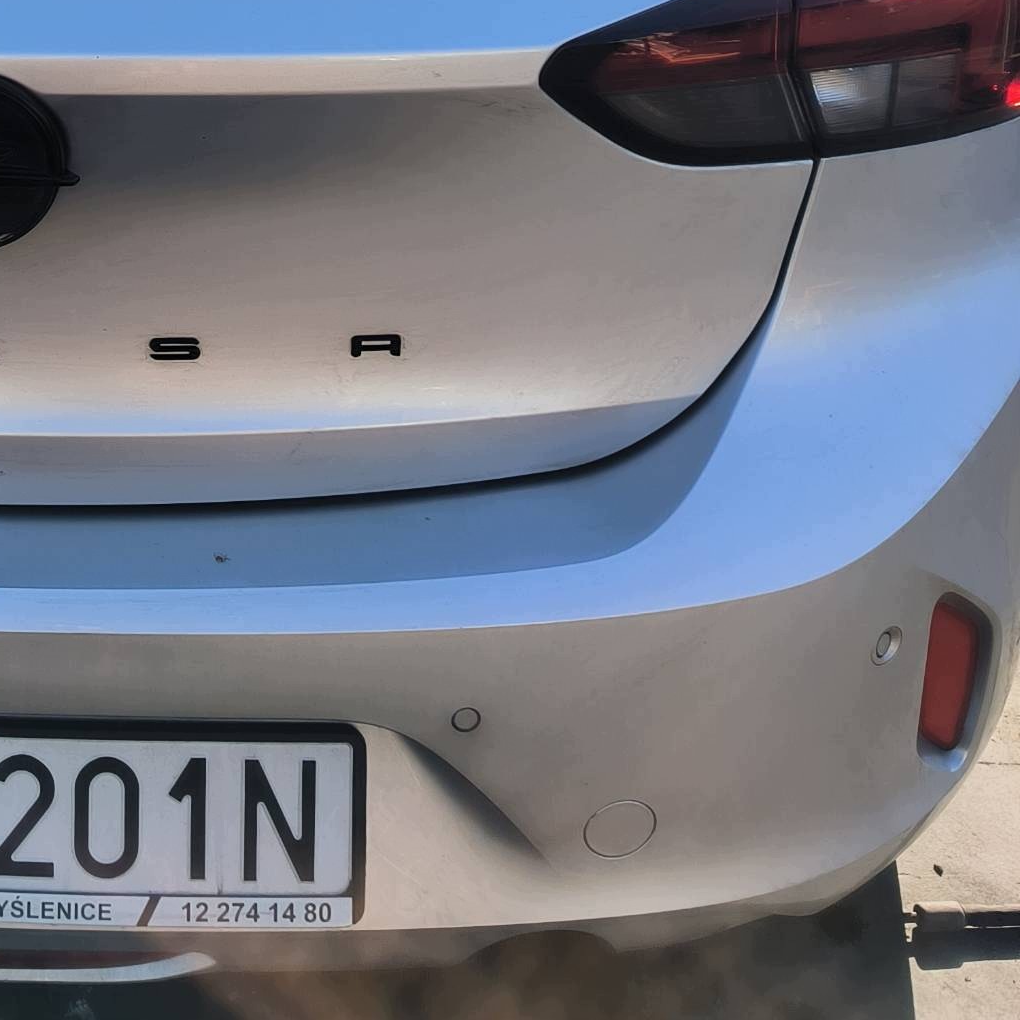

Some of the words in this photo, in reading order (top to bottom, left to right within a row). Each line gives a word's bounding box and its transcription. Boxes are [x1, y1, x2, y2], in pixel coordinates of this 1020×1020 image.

[181, 902, 208, 923] 12
[217, 902, 260, 923] 274
[269, 902, 296, 923] 14
[304, 902, 332, 923] 80
